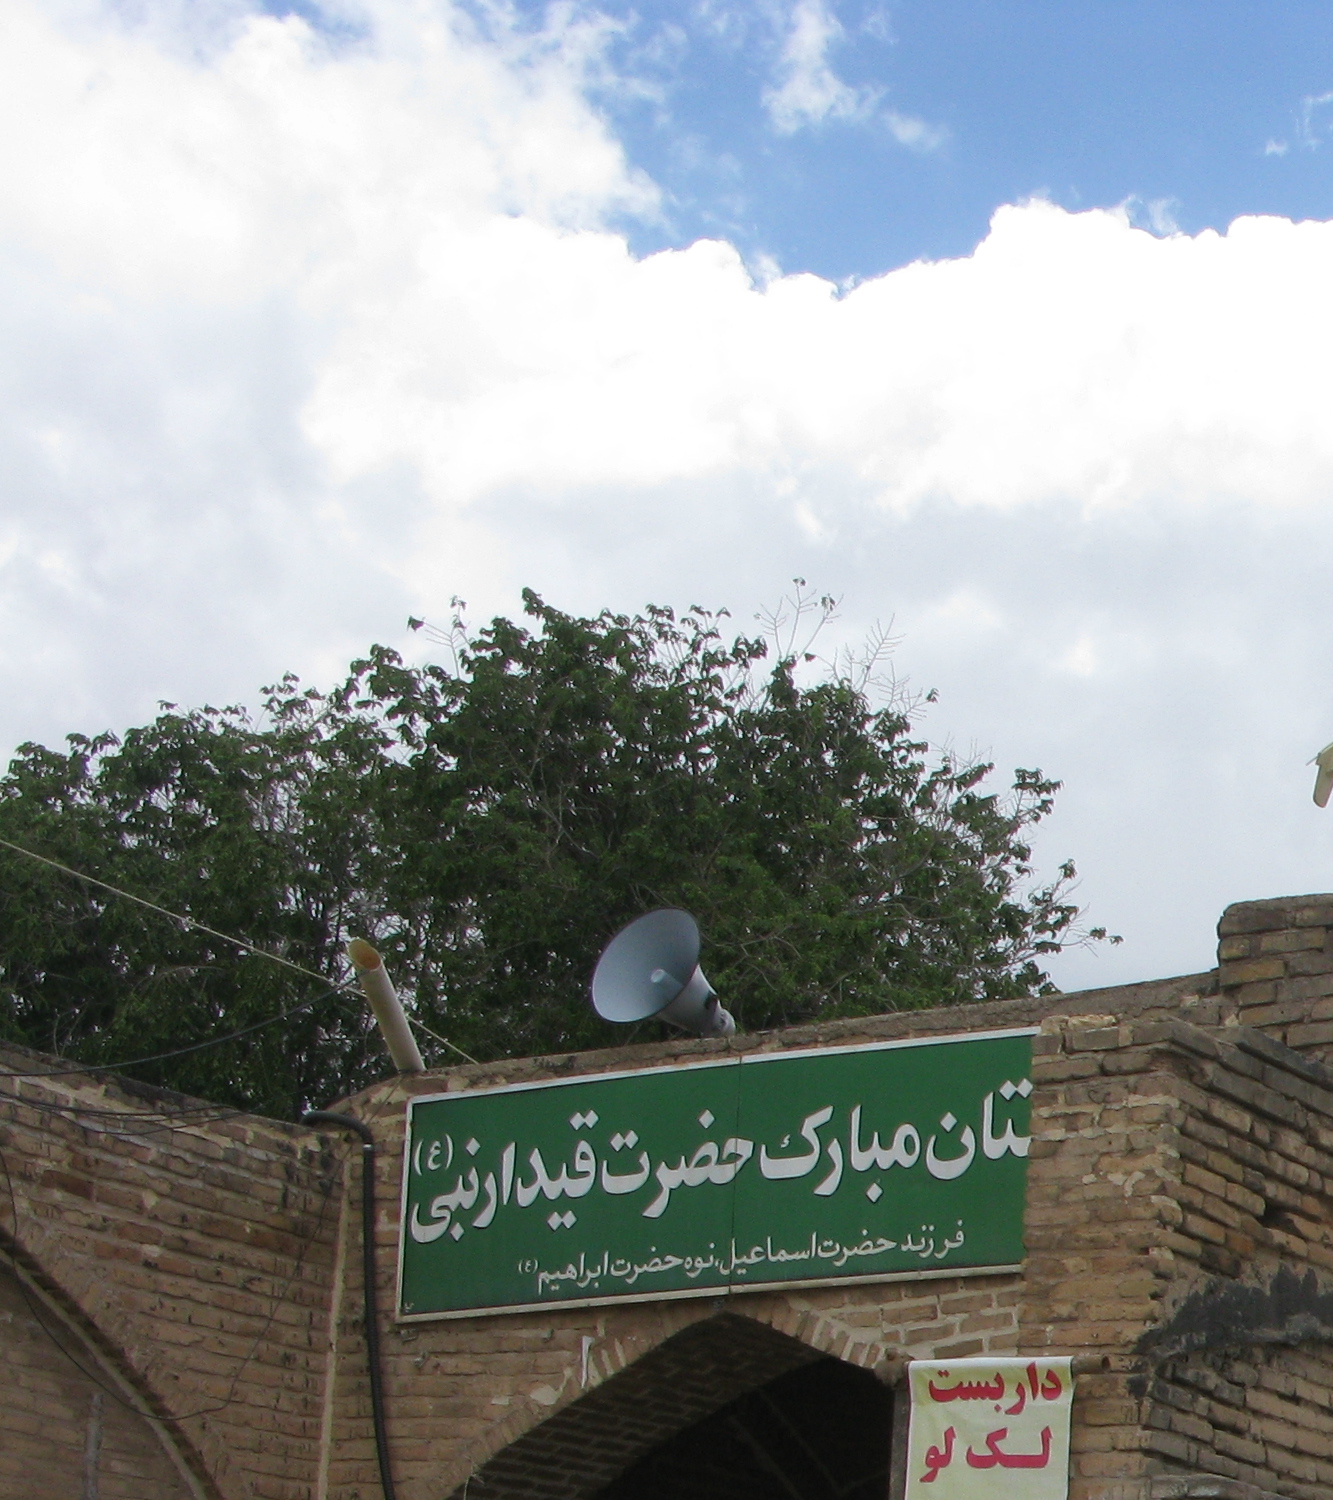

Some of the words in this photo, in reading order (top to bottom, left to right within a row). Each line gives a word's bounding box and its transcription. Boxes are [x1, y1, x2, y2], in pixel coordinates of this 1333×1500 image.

[601, 1109, 754, 1219] حضرت
[760, 1104, 921, 1203] مبارک
[817, 1229, 897, 1267] حضرت
[901, 1219, 965, 1259] فرزند
[538, 1250, 609, 1295] ابراهیم
[611, 1245, 684, 1284] حضرت
[684, 1242, 715, 1278] نوه
